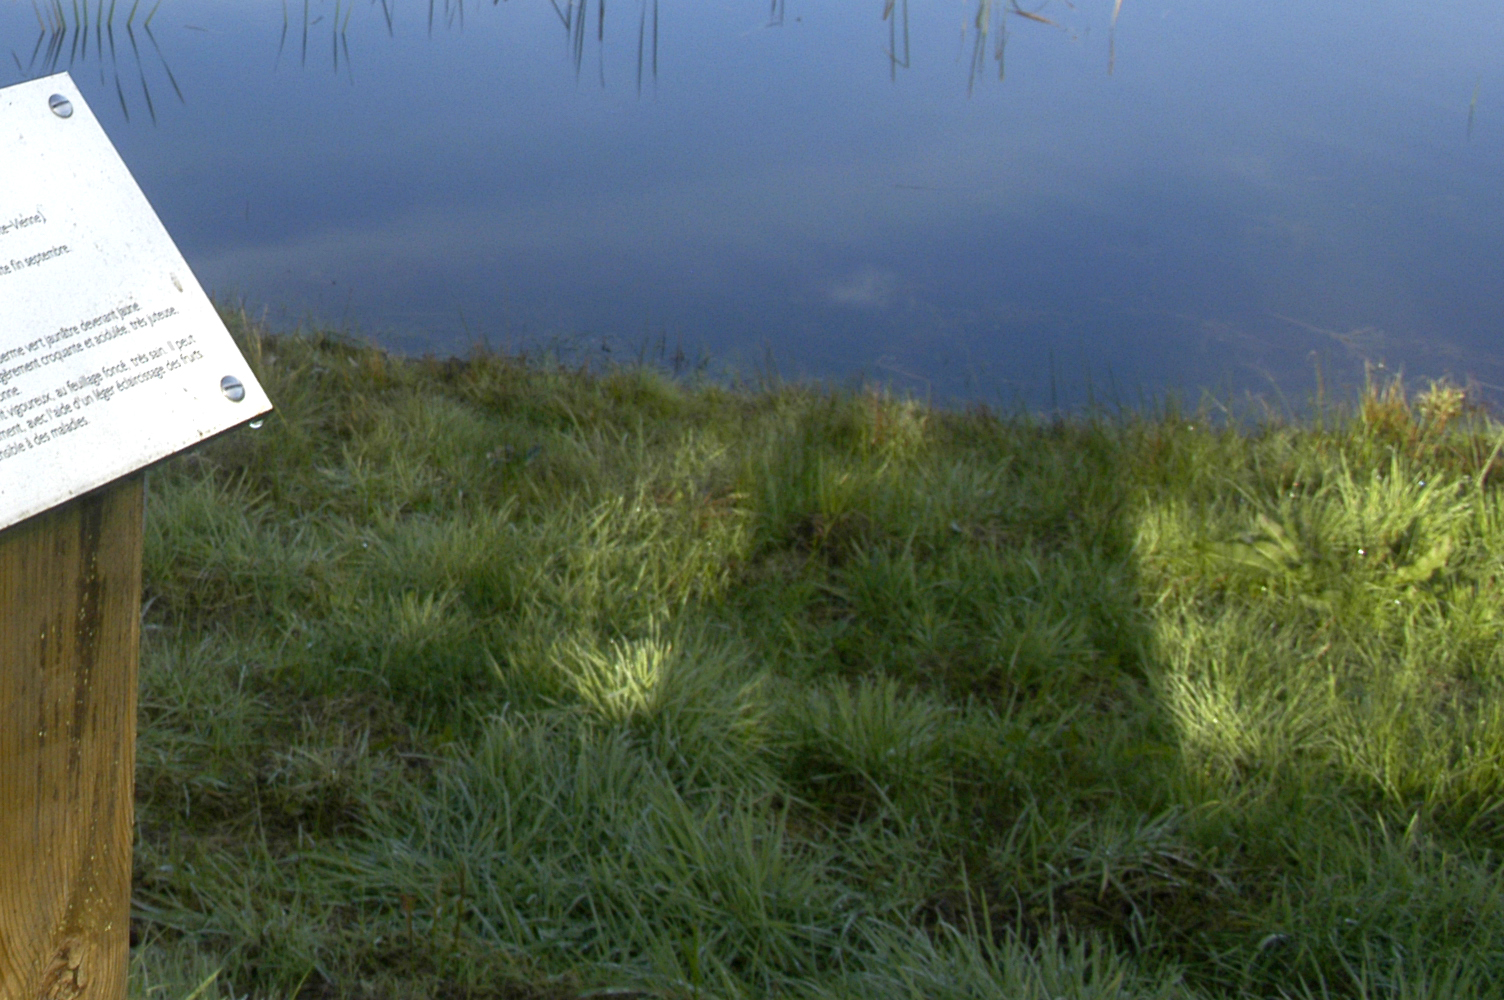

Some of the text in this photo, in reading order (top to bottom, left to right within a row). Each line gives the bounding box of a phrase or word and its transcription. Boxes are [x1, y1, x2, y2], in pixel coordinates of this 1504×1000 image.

[9, 258, 25, 271] fin
[24, 337, 46, 353] vert
[44, 325, 81, 349] jaunâtre
[79, 309, 119, 332] devenant
[40, 342, 85, 366] croquante
[83, 337, 96, 349] et
[129, 317, 148, 331] très
[54, 386, 68, 398] au
[65, 372, 104, 392] feuillage
[129, 353, 150, 368] très
[175, 334, 196, 352] peut
[26, 413, 49, 430] avec
[92, 385, 115, 402] léger
[115, 365, 166, 393] éclaircissage
[165, 359, 182, 372] des
[24, 437, 34, 449] à
[33, 432, 51, 446] des
